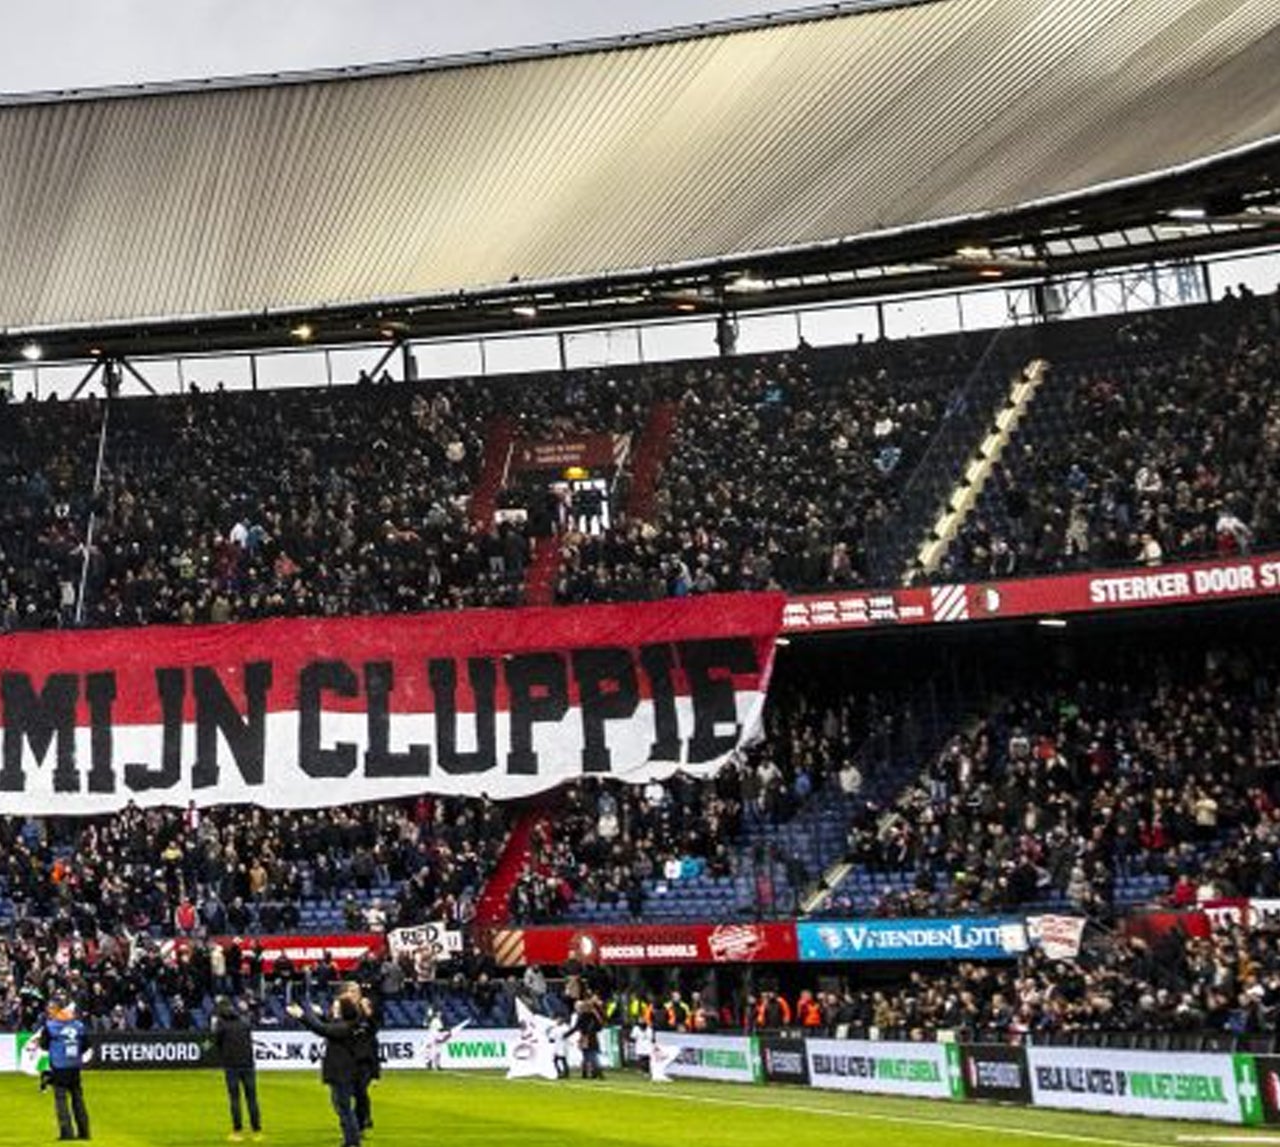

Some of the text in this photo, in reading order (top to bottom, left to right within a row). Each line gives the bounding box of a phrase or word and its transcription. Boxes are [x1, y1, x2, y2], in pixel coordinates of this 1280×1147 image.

[1090, 573, 1190, 602] STERKER
[1193, 565, 1256, 594] DOOR
[297, 636, 759, 779] CLUPPIE
[101, 1041, 201, 1061] FEYENOORD
